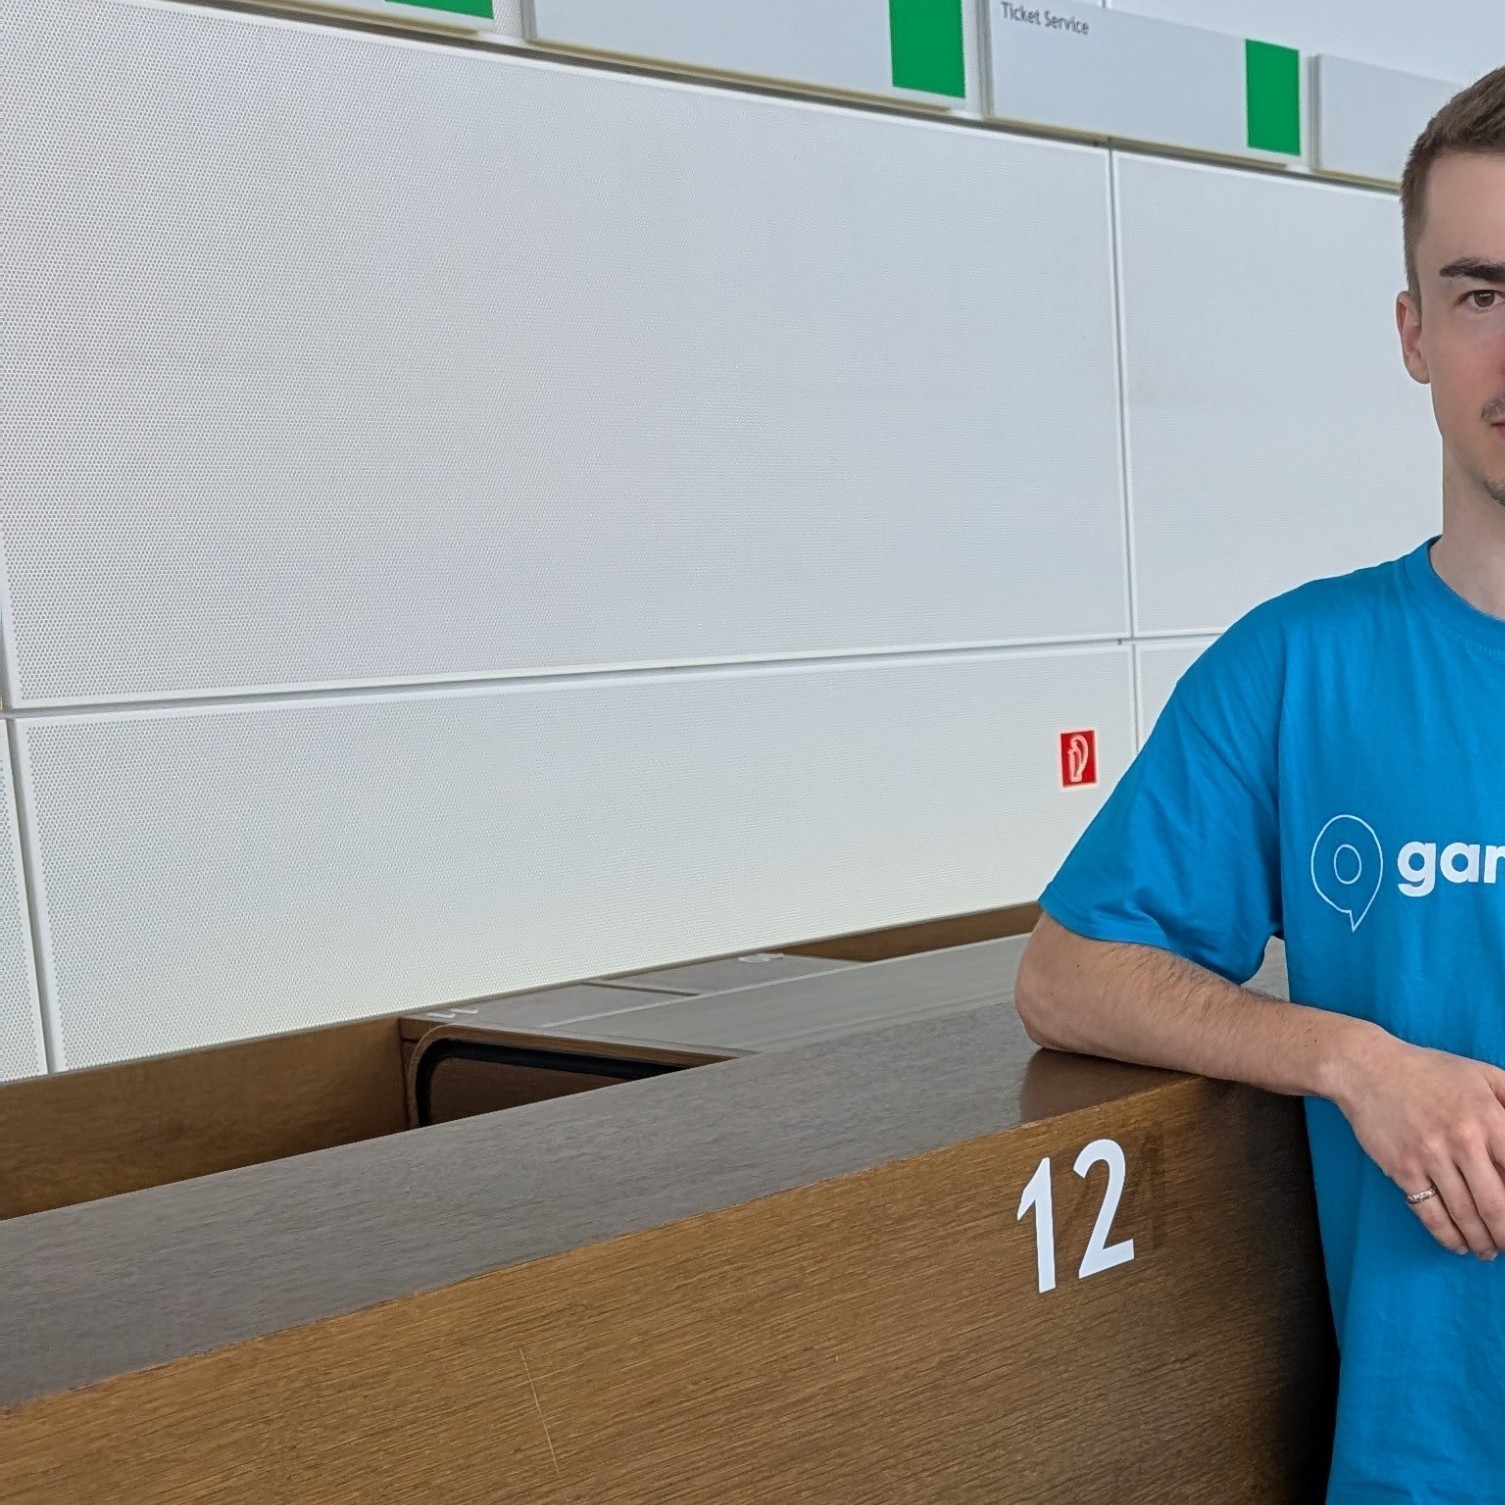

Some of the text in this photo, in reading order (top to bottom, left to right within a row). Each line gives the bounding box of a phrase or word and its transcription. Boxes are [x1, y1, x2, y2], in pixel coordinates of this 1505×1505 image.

[1001, 1, 1089, 35] Ticket Service
[1017, 1139, 1134, 1293] 12
